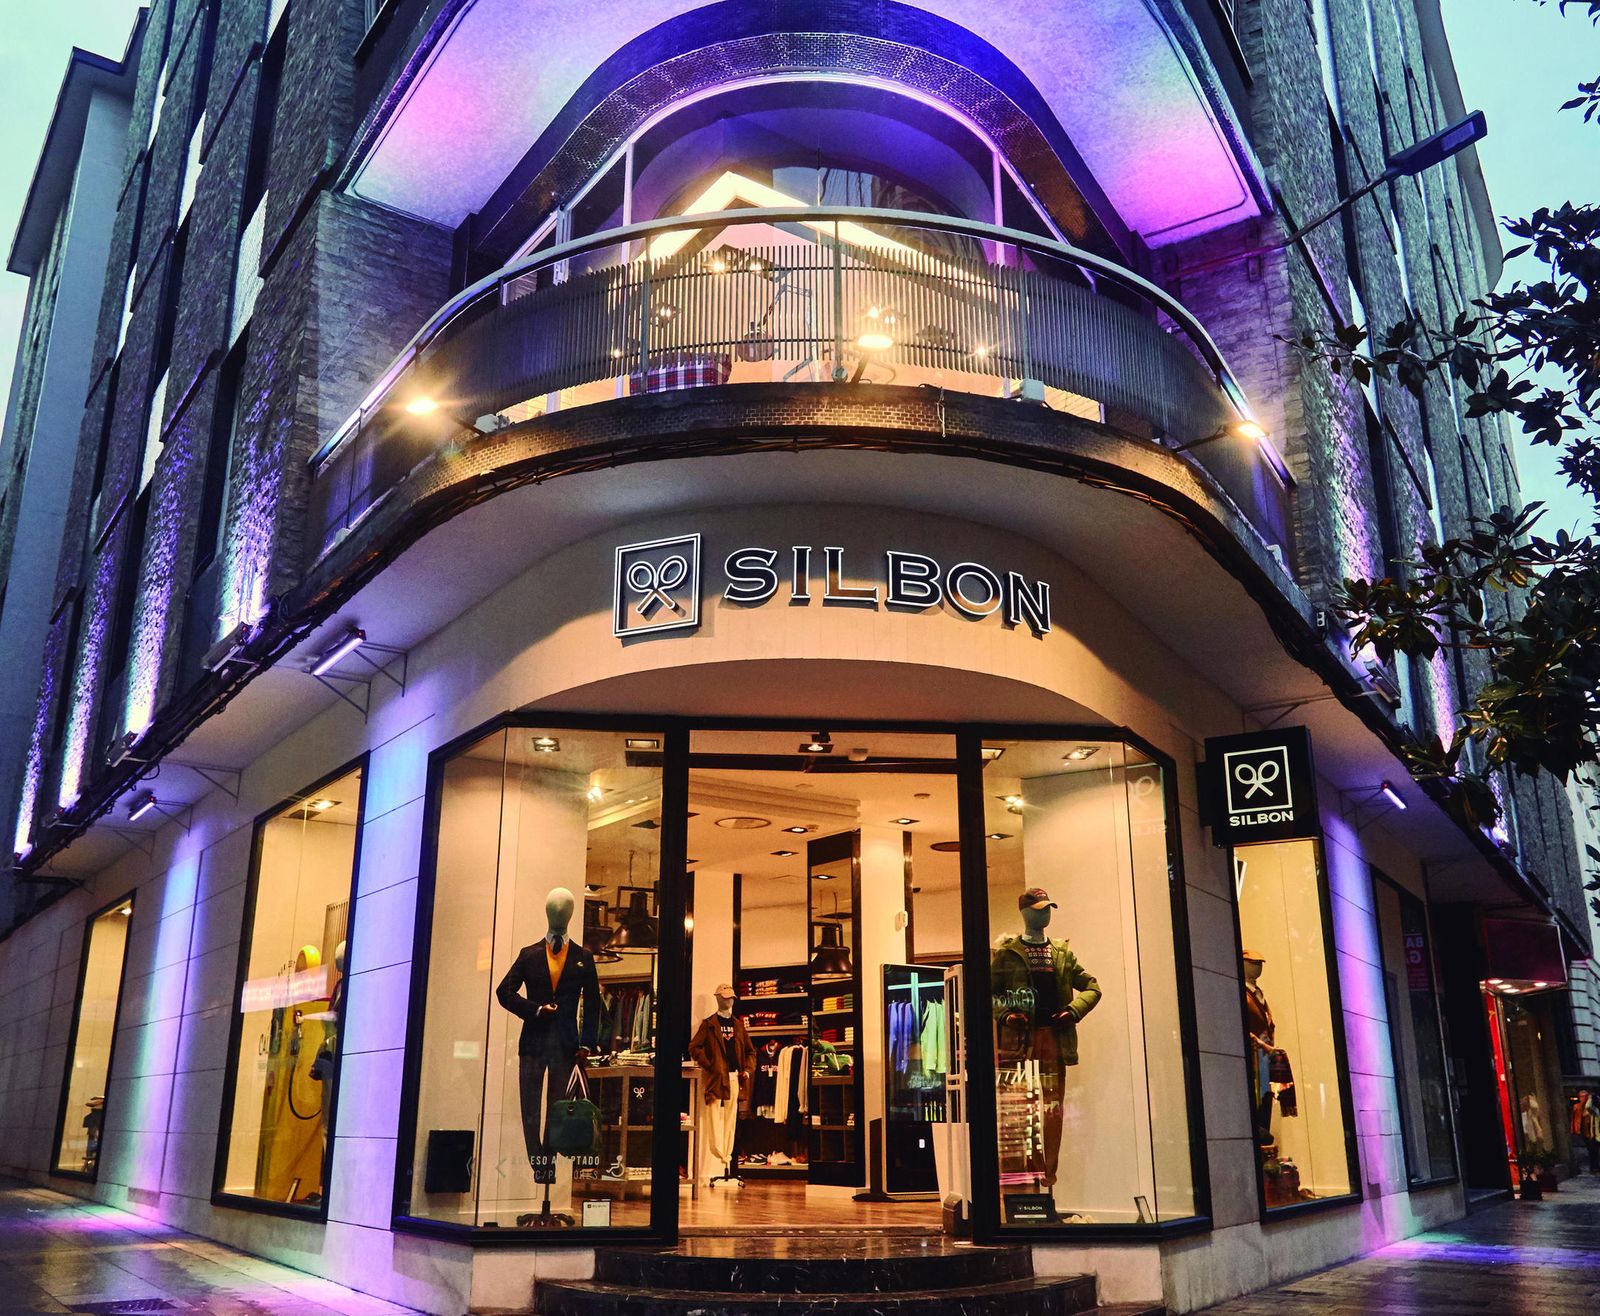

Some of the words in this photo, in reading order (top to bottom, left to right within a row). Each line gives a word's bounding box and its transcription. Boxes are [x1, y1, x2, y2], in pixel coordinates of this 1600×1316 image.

[723, 546, 1052, 634] SILBON
[1229, 810, 1295, 827] SILBON
[551, 1154, 600, 1166] APTADO
